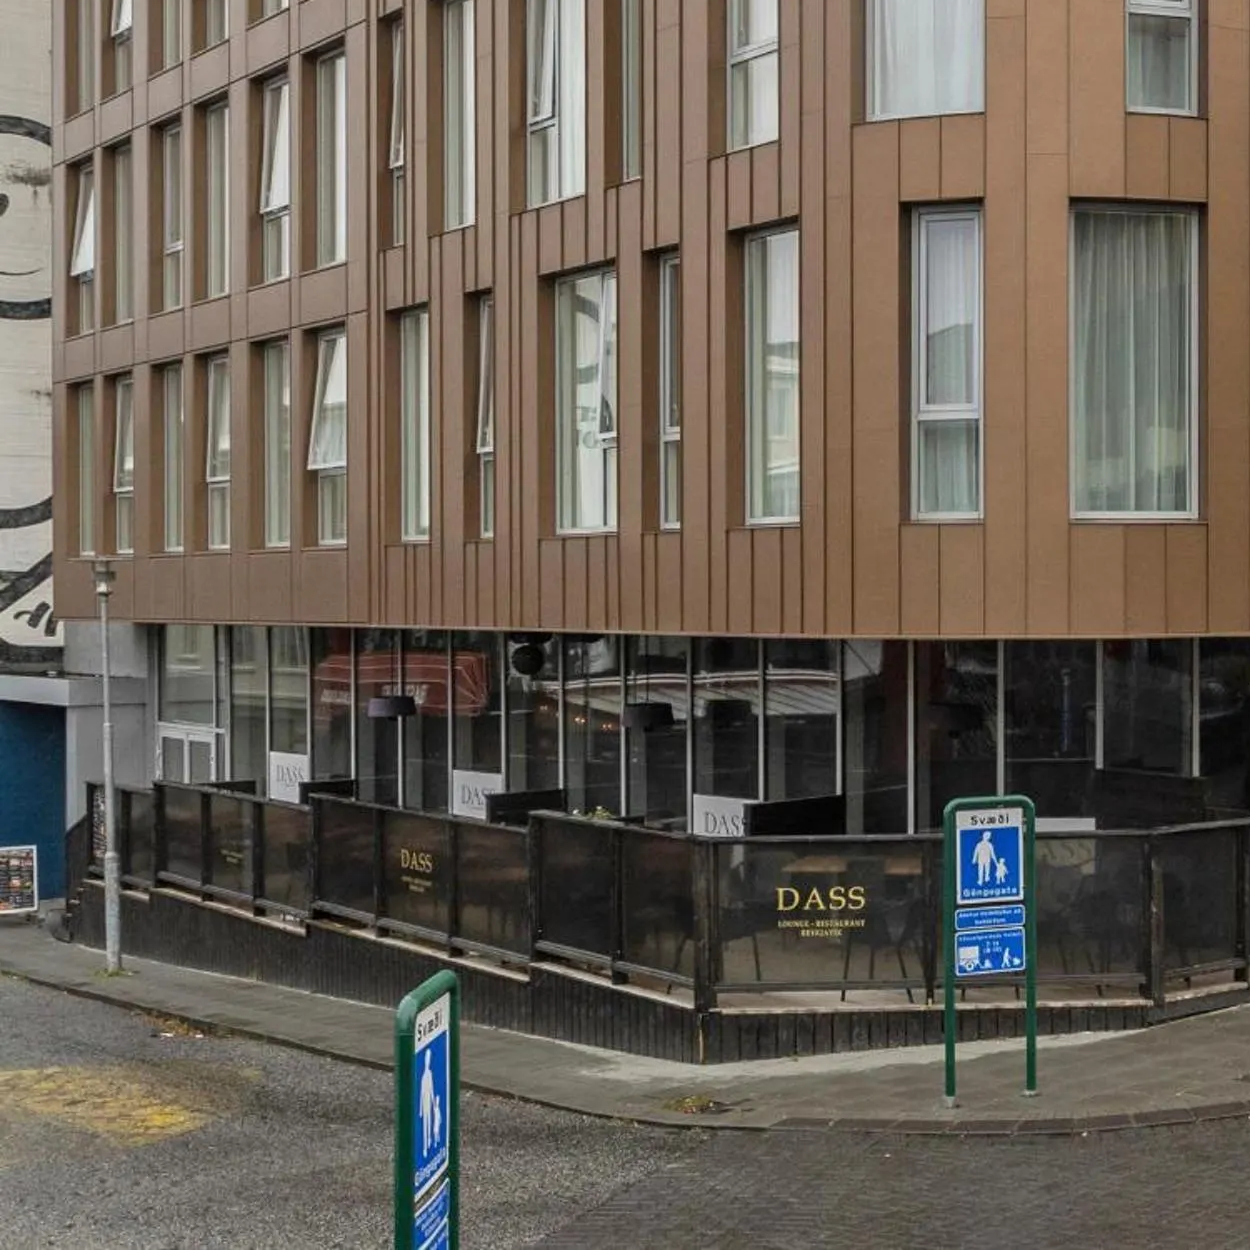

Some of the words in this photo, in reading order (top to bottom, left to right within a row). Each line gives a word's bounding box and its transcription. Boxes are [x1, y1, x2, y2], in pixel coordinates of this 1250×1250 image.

[704, 811, 745, 837] DAS
[400, 848, 433, 874] DASS
[775, 885, 866, 911] DASS
